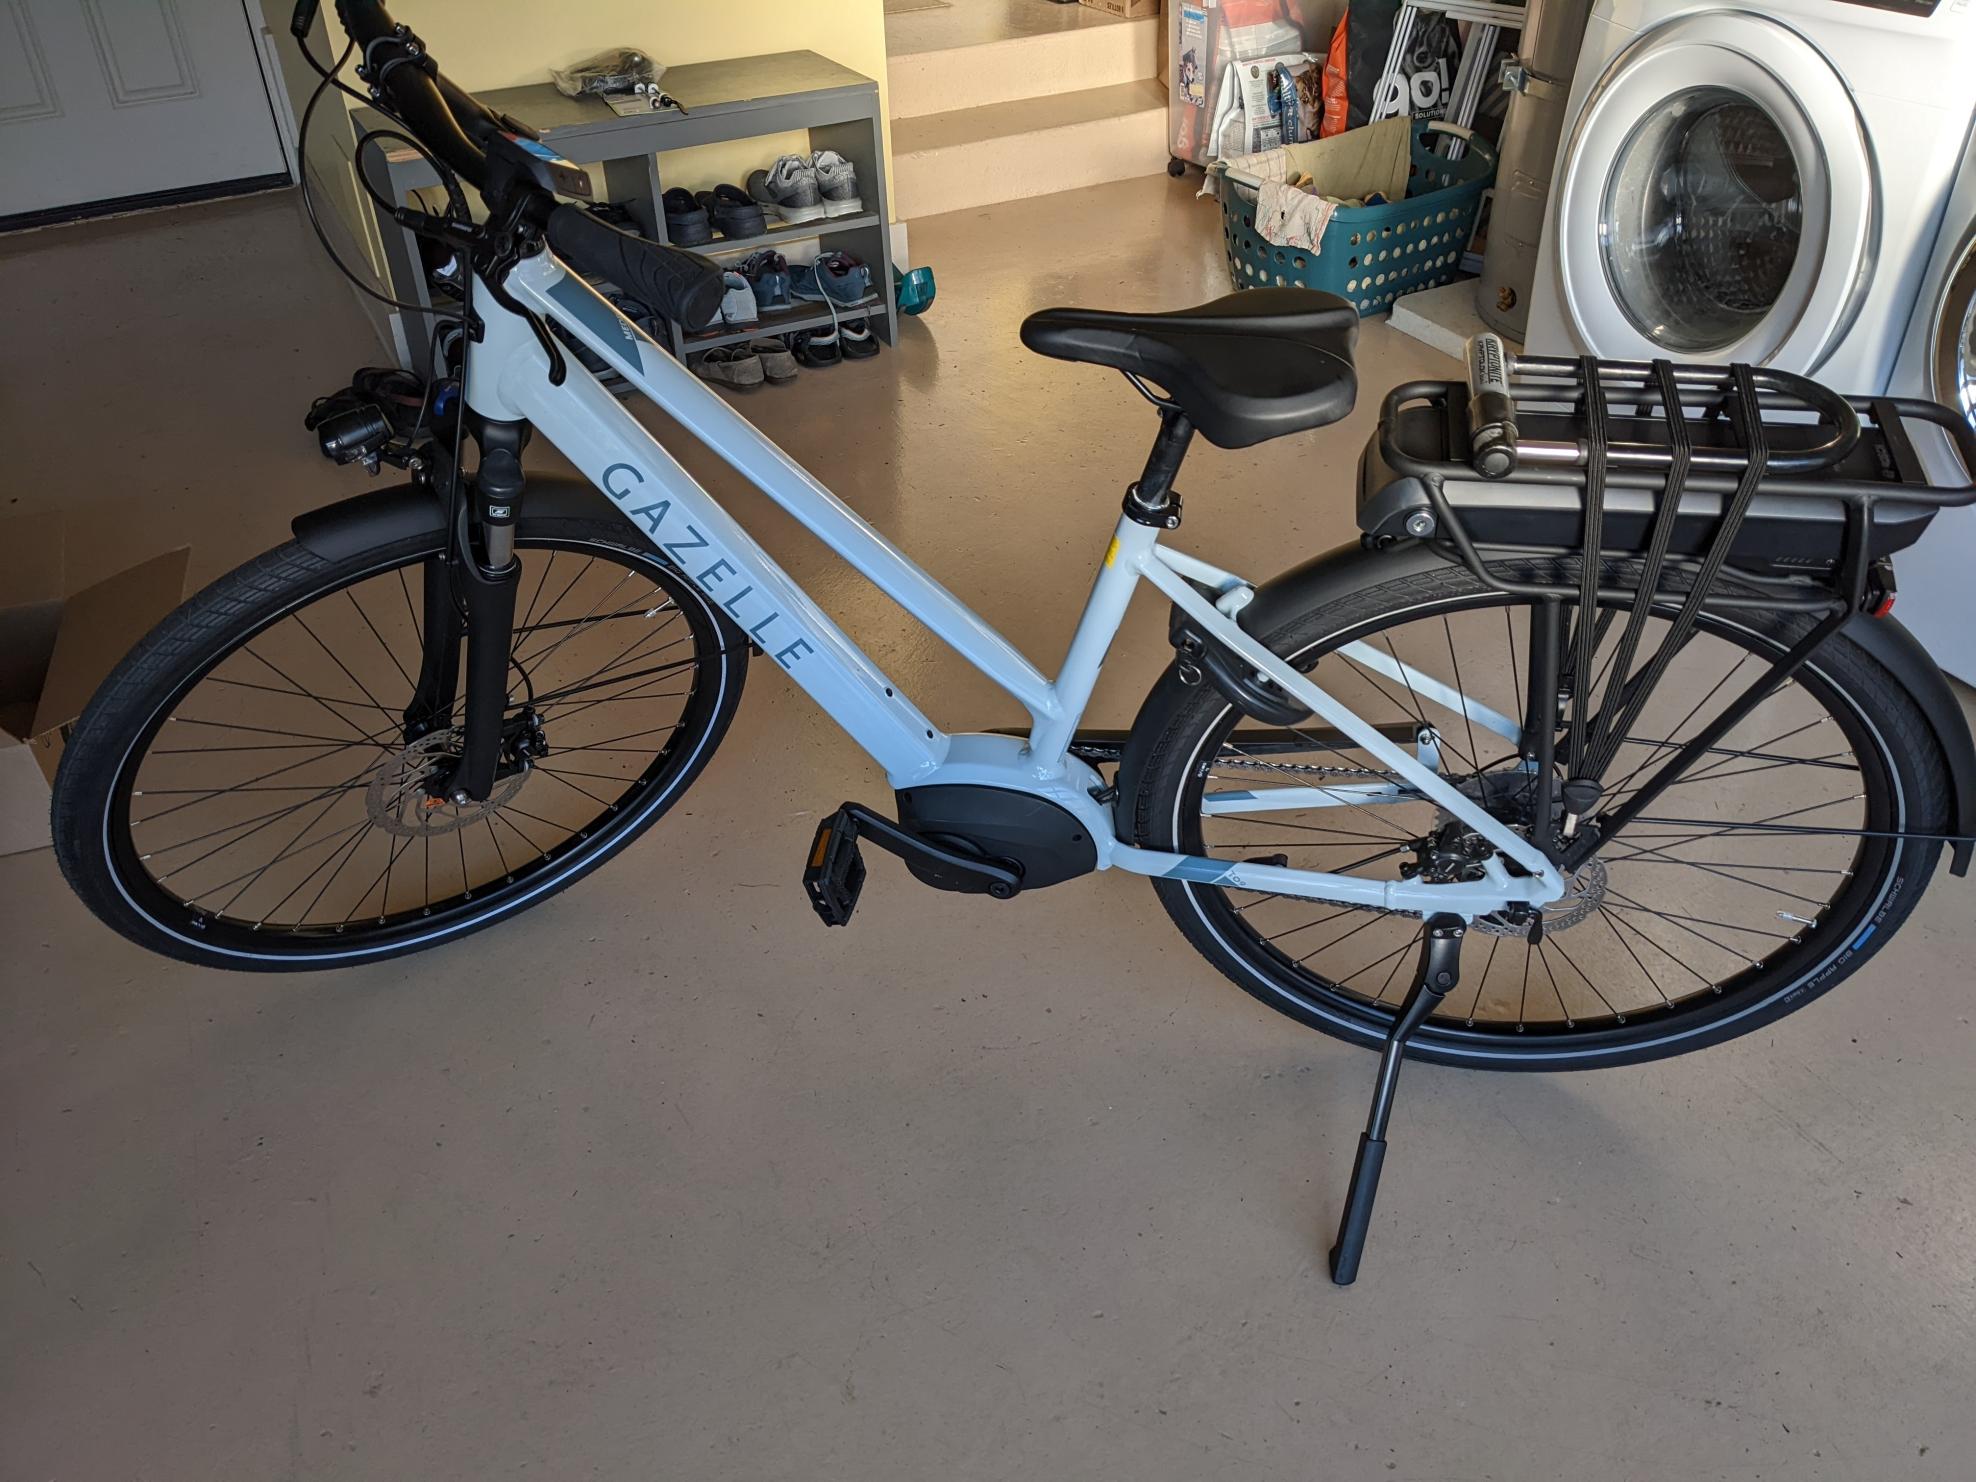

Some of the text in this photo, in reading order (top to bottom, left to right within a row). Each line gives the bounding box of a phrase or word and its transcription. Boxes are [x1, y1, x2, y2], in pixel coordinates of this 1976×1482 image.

[1486, 338, 1502, 385] KRYPTONITE
[601, 463, 815, 669] GAZELLE
[1874, 875, 1904, 924] SCHWALBE
[1807, 964, 1838, 989] APPLE
